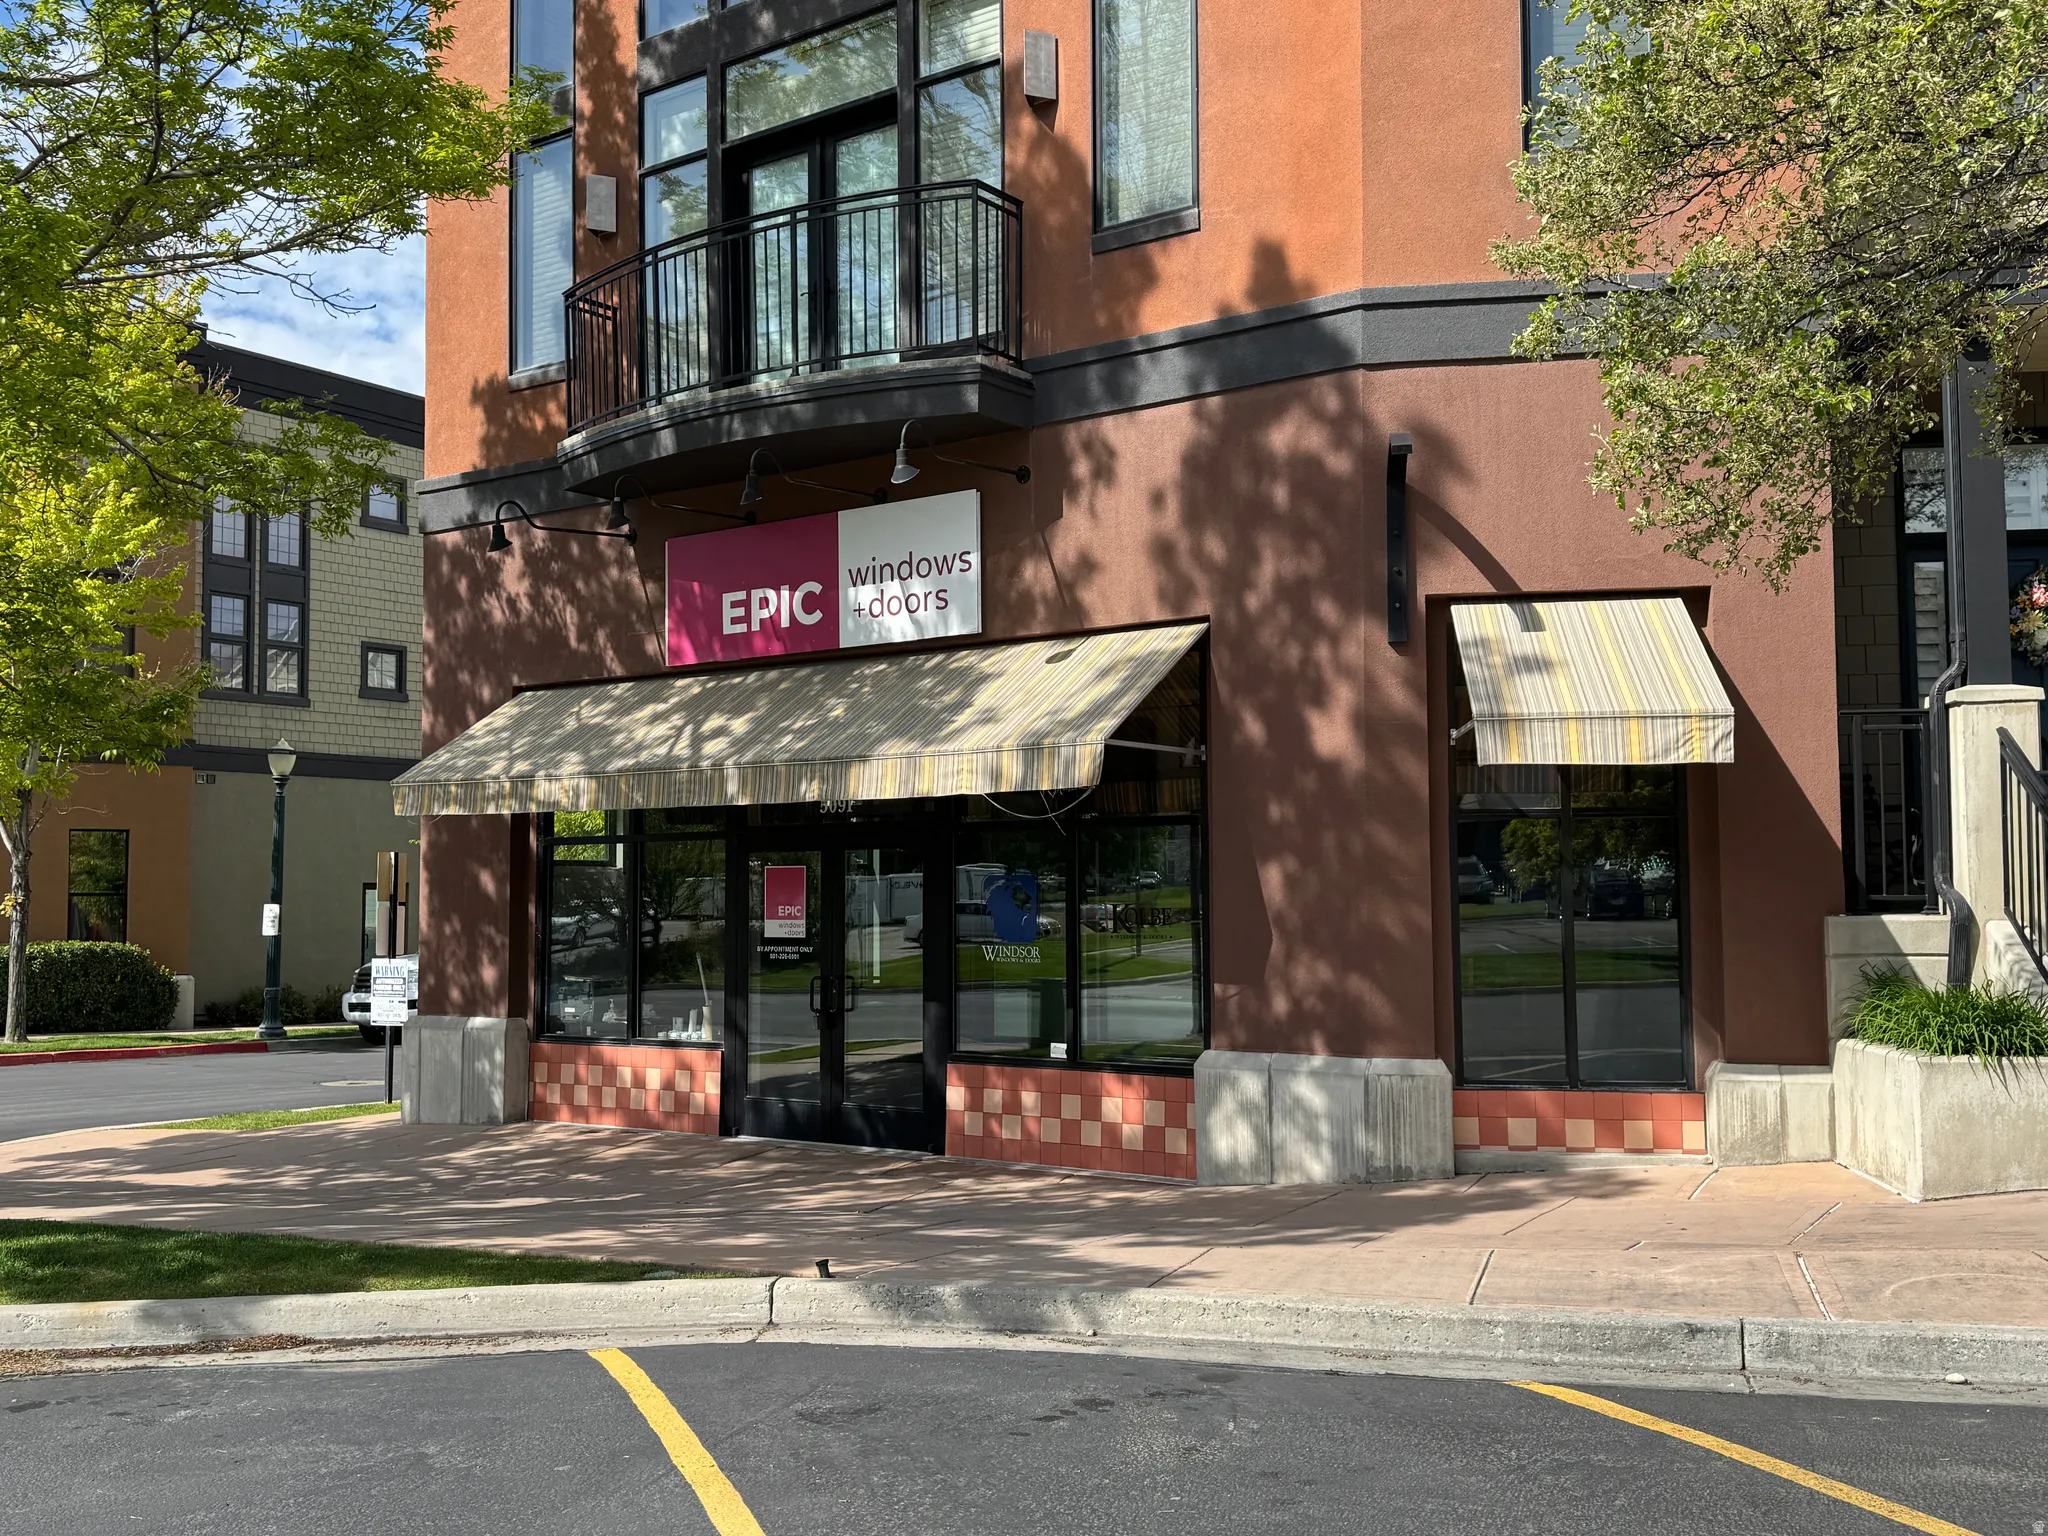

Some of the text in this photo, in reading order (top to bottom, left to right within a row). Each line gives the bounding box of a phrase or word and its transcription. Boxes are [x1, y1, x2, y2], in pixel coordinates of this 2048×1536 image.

[847, 551, 973, 588] windows
[722, 581, 823, 635] EPIC
[853, 587, 949, 619] +doors
[778, 905, 802, 917] EPIC
[1112, 904, 1172, 933] KOLBE
[778, 921, 805, 929] windows
[764, 945, 799, 953] APPOINTMENT
[981, 945, 1041, 962] WINDSOR
[375, 965, 405, 977] WARNING
